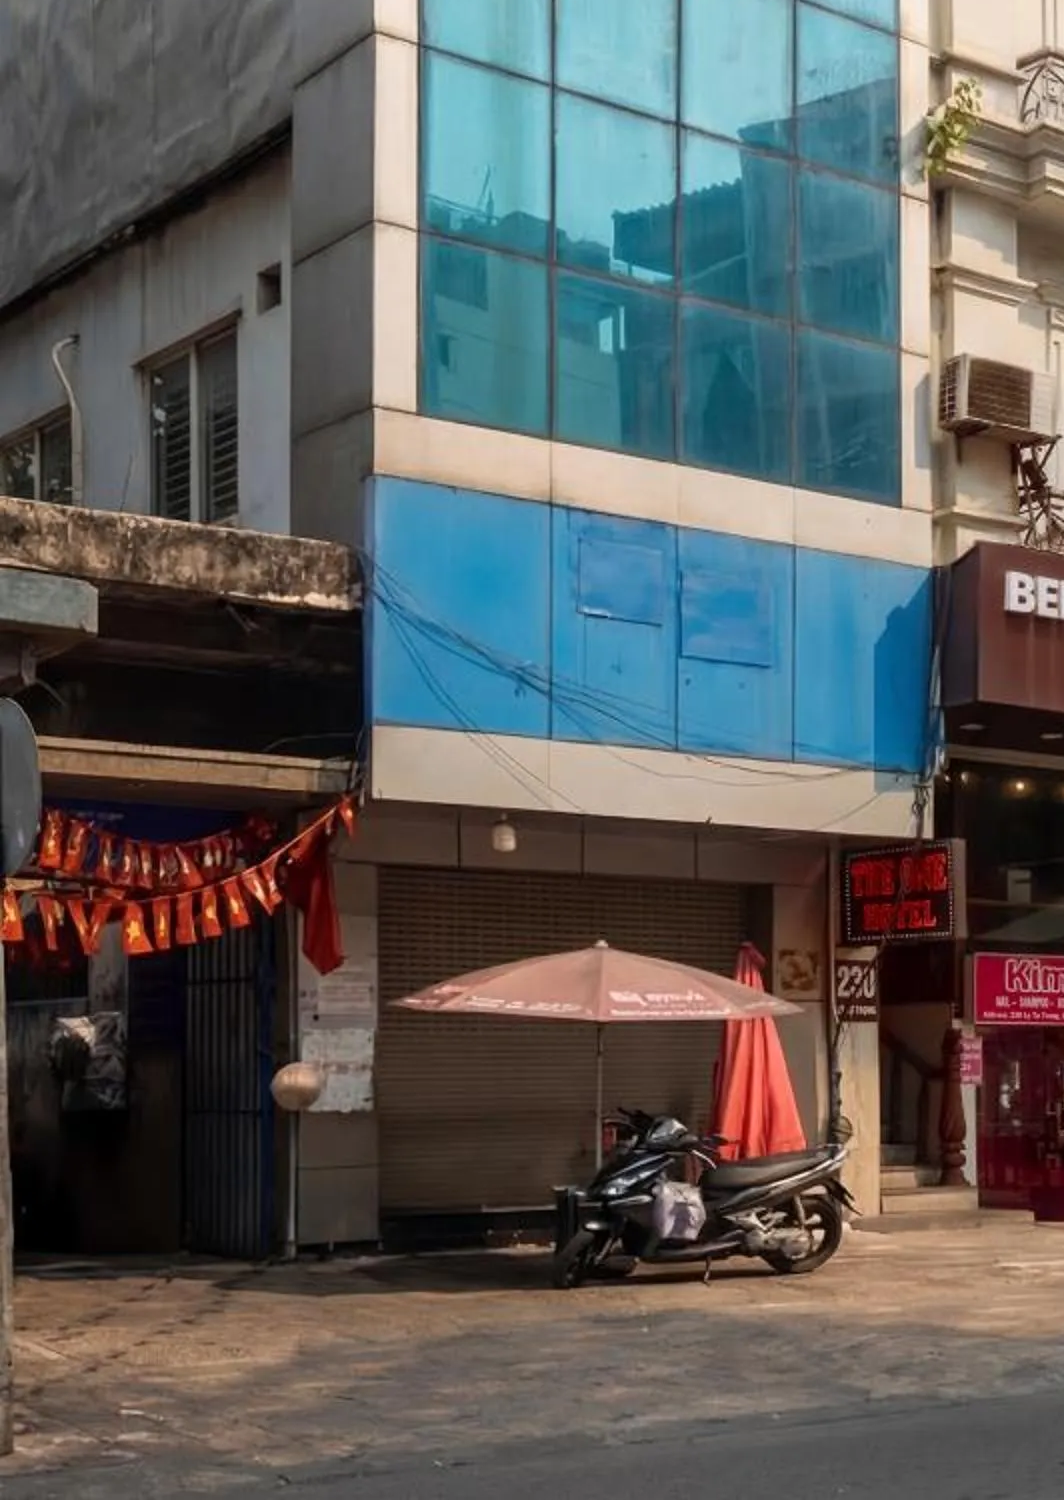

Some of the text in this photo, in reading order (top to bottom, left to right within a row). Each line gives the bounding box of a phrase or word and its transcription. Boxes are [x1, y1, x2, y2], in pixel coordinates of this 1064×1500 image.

[851, 852, 948, 896] THE ONE
[863, 900, 937, 931] HOTEL
